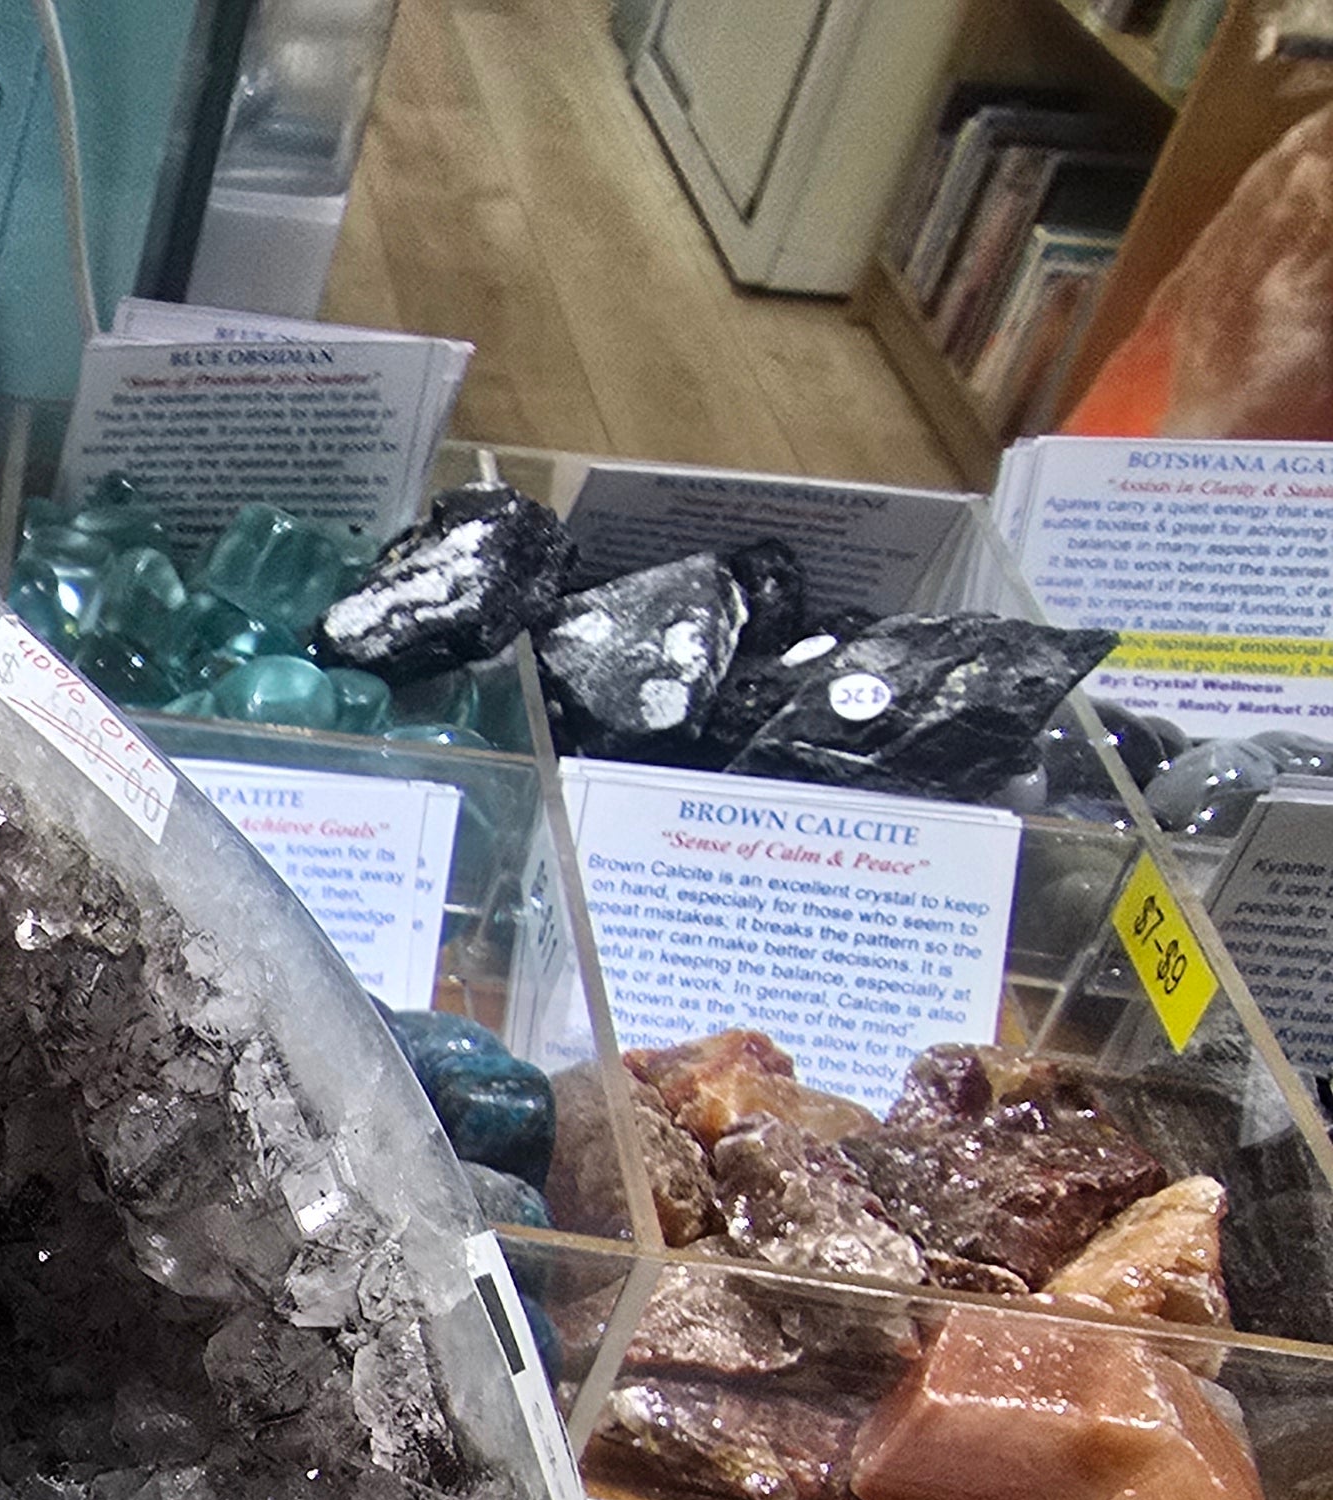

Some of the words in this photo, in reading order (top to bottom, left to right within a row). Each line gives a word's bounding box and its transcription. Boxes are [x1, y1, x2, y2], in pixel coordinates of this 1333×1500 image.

[1128, 451, 1266, 473] BOTSWANA
[1099, 673, 1127, 691] By:
[1132, 675, 1198, 692] Crystal
[1202, 677, 1285, 695] Wellness
[18, 639, 87, 705] 40%
[99, 717, 163, 775] OFF
[1177, 698, 1232, 717] Manly
[1236, 701, 1302, 717] Market
[679, 800, 788, 831] BROWN
[795, 814, 919, 846] CALCITE
[285, 842, 343, 863] known
[347, 845, 372, 861] for
[375, 846, 397, 862] its
[662, 831, 732, 854] “Sense
[736, 842, 761, 861] of
[765, 841, 821, 866] Calm
[826, 846, 845, 866] &
[854, 852, 930, 877] Peace”
[286, 860, 299, 876] It
[301, 862, 355, 881] clears
[359, 867, 406, 887] away
[588, 854, 646, 873] Brown
[651, 860, 714, 883] Calcite
[718, 872, 734, 886] is
[738, 874, 763, 887] an
[767, 878, 850, 899] excellent
[855, 888, 916, 907] crystal
[921, 895, 939, 910] to
[944, 897, 990, 918] keep
[1134, 894, 1188, 995] $7-$9
